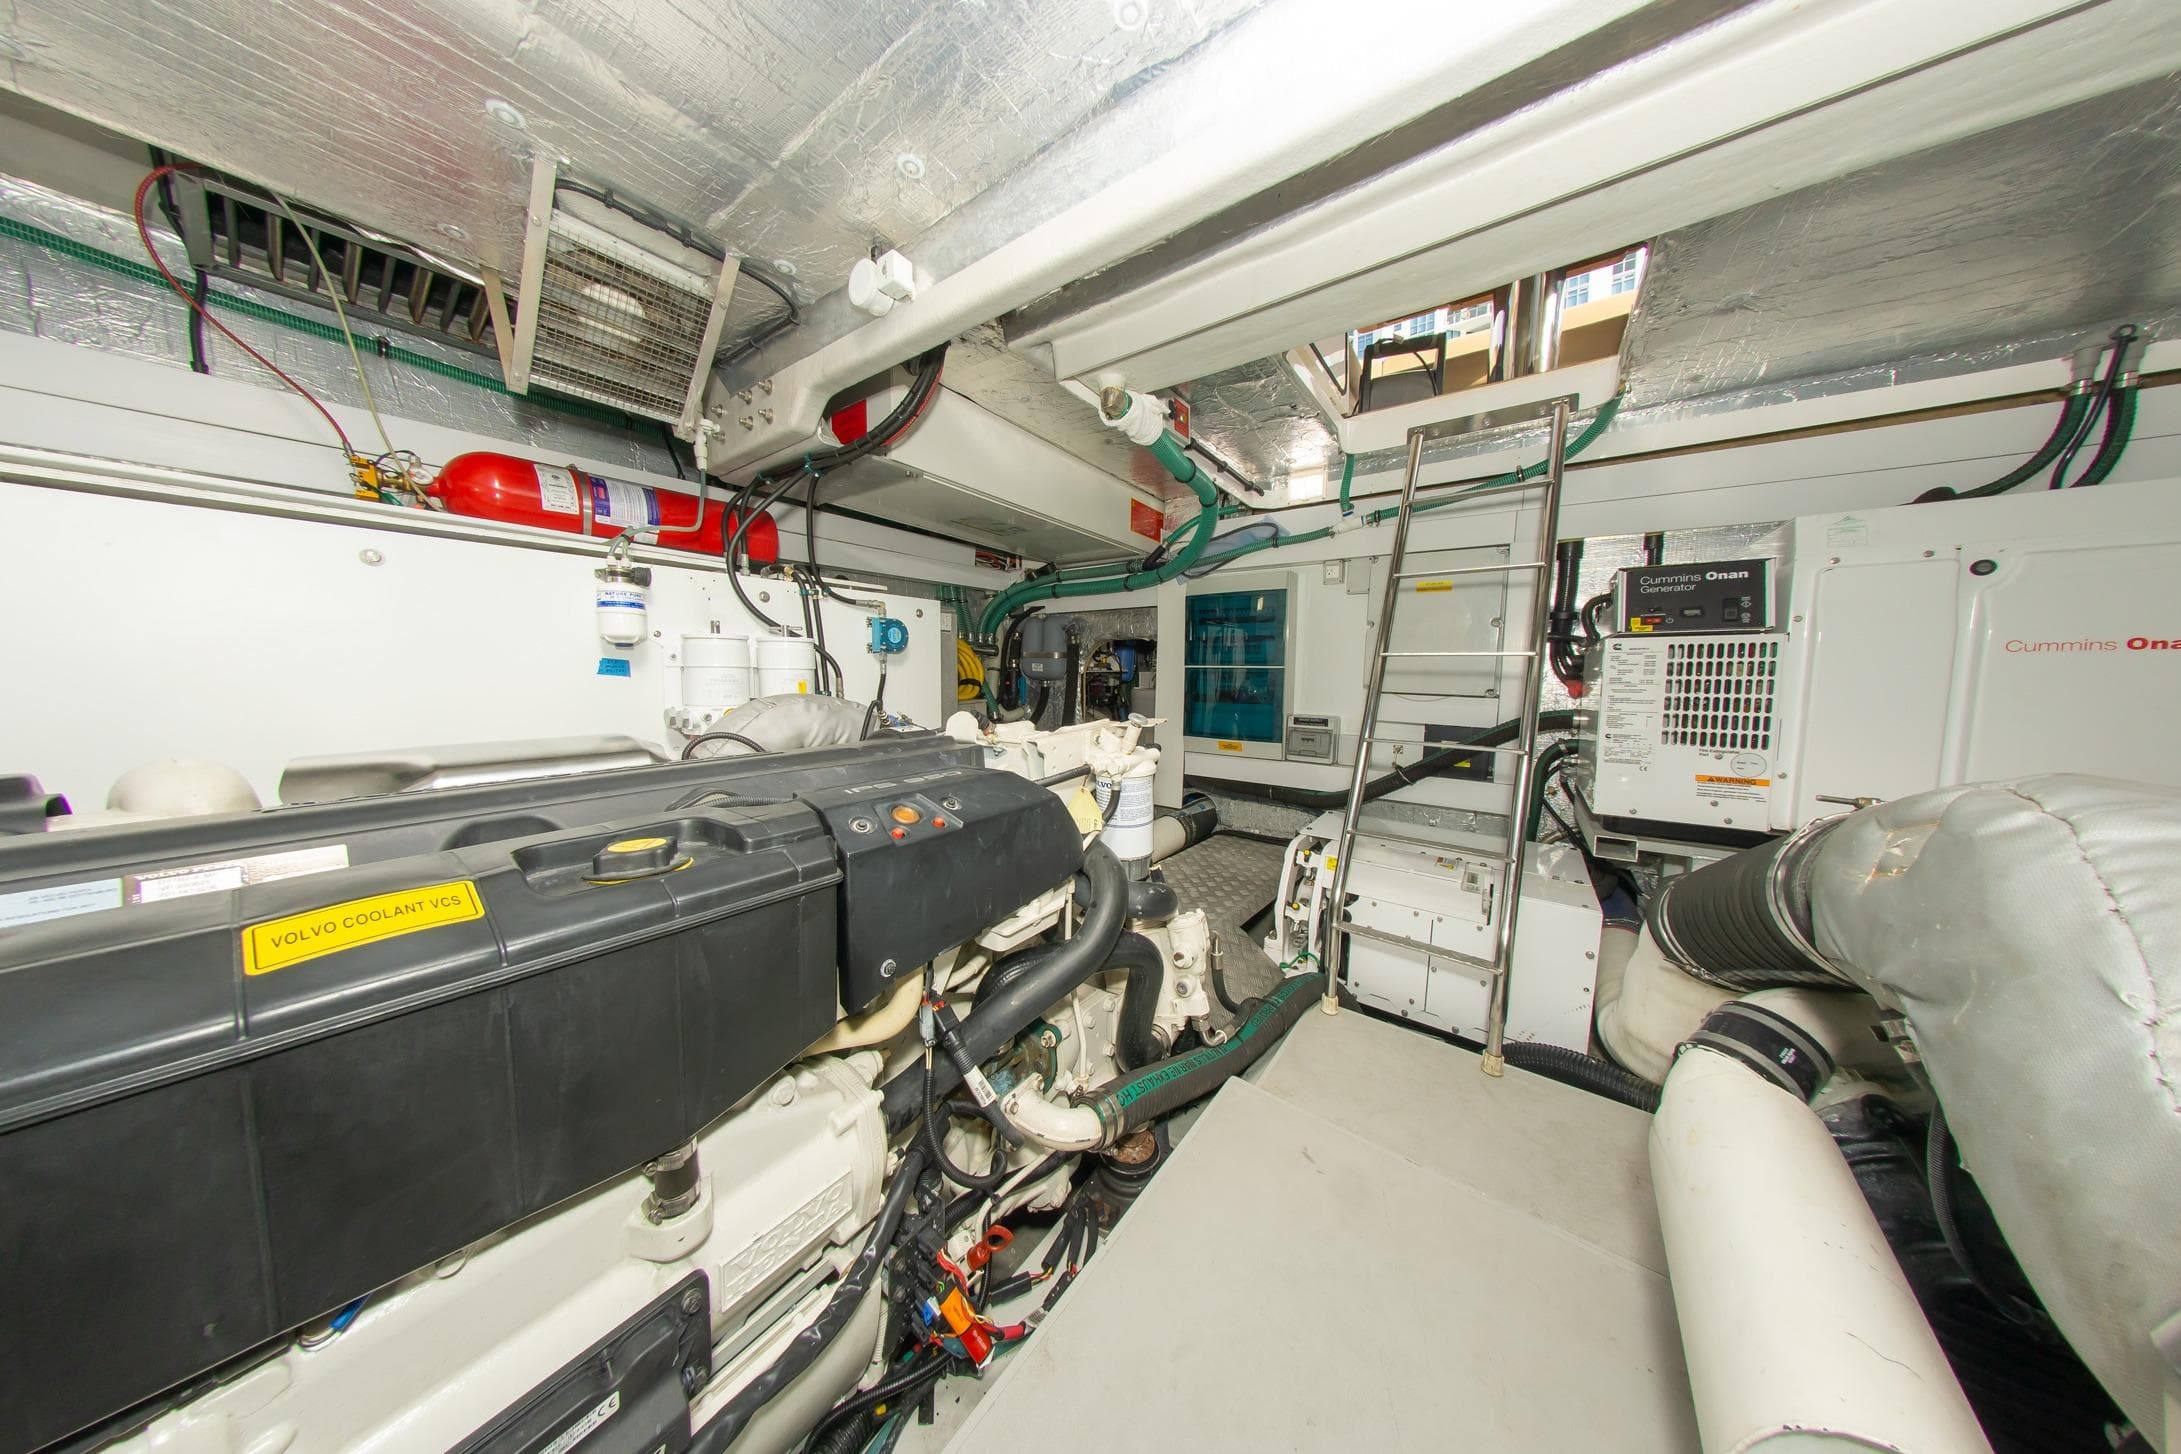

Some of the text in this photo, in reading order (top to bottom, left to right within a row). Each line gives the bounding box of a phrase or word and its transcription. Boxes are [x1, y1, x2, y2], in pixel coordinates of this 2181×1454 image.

[1640, 571, 1749, 586] Cummins Onan
[1640, 584, 1696, 594] Generator
[2005, 639, 2118, 653] Cummins
[1715, 776, 1757, 786] WARNING
[271, 895, 462, 949] VOLVO COOLANT VCS
[1134, 1069, 1171, 1098] EXHAUST
[730, 1182, 845, 1271] VOLVO
